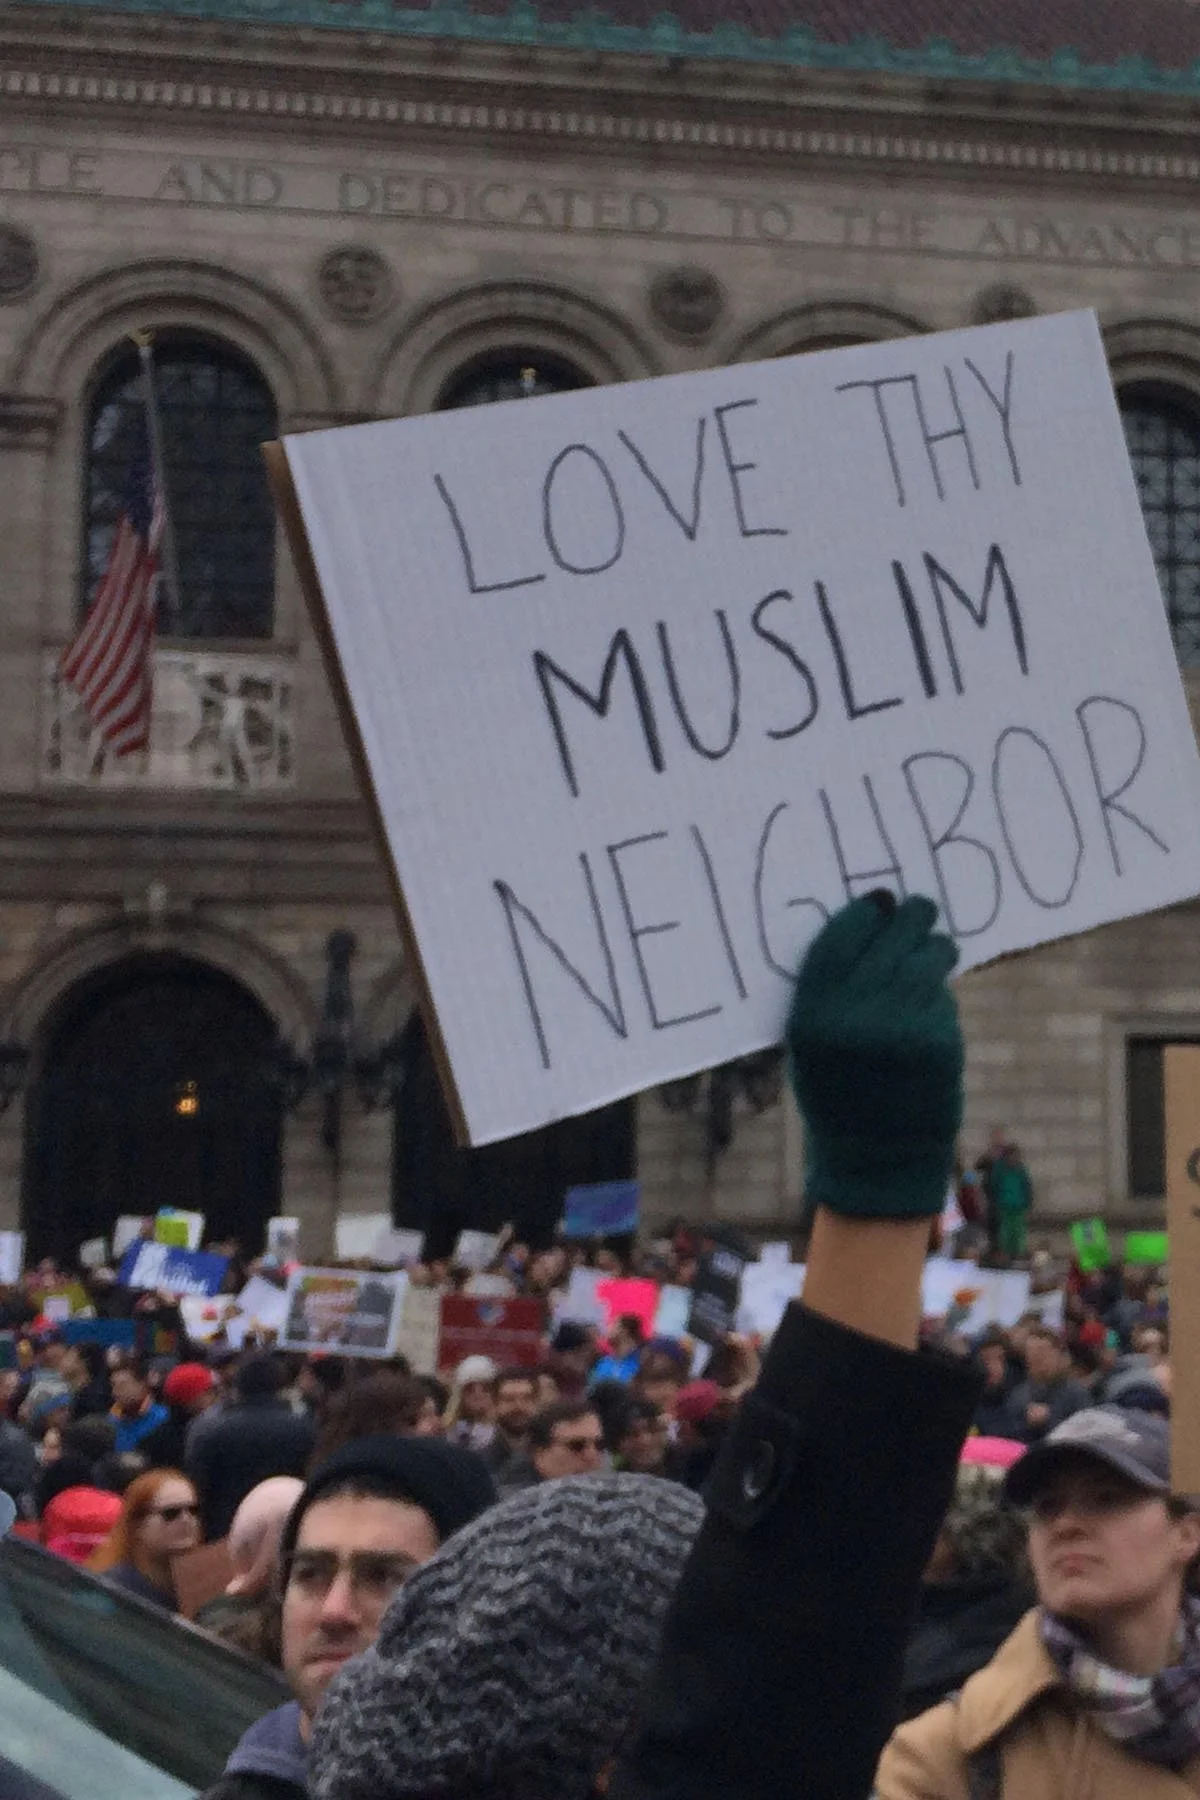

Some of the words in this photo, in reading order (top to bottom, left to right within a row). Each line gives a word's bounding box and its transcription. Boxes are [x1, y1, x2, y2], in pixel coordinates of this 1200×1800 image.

[156, 161, 284, 205] AND
[337, 172, 670, 234] DEDICATED
[719, 198, 794, 241] TO
[831, 204, 939, 251] THE
[435, 399, 788, 592] LOVE
[836, 351, 1022, 506] THY
[533, 543, 1028, 798] MUSLIM
[493, 695, 1170, 1068] NEIGHBOR
